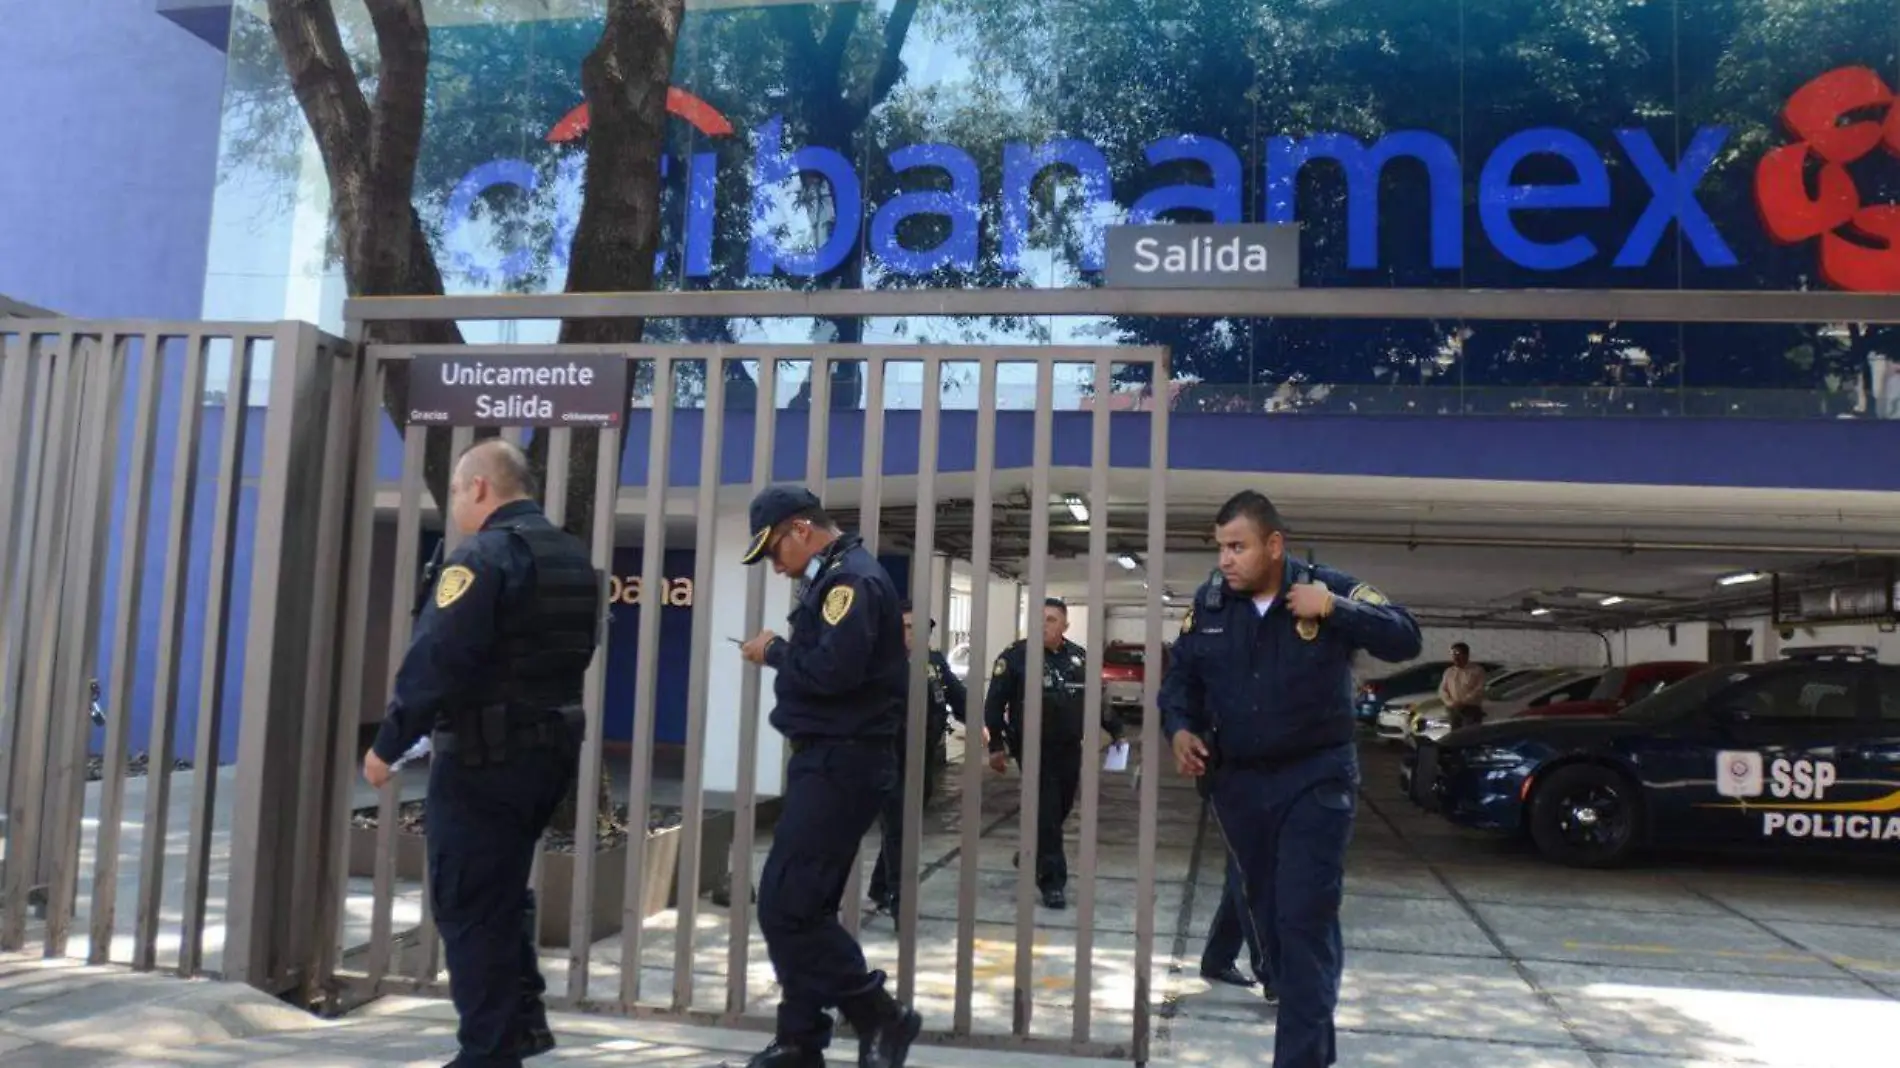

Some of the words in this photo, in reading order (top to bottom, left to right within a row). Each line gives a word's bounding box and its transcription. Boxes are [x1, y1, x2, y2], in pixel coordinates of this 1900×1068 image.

[444, 113, 1740, 281] ciibanamex
[1133, 236, 1267, 272] Salida
[441, 362, 593, 386] Unicamente
[475, 395, 553, 418] Salida
[1770, 758, 1836, 799] SSP
[1763, 813, 1900, 839] POLICIA
